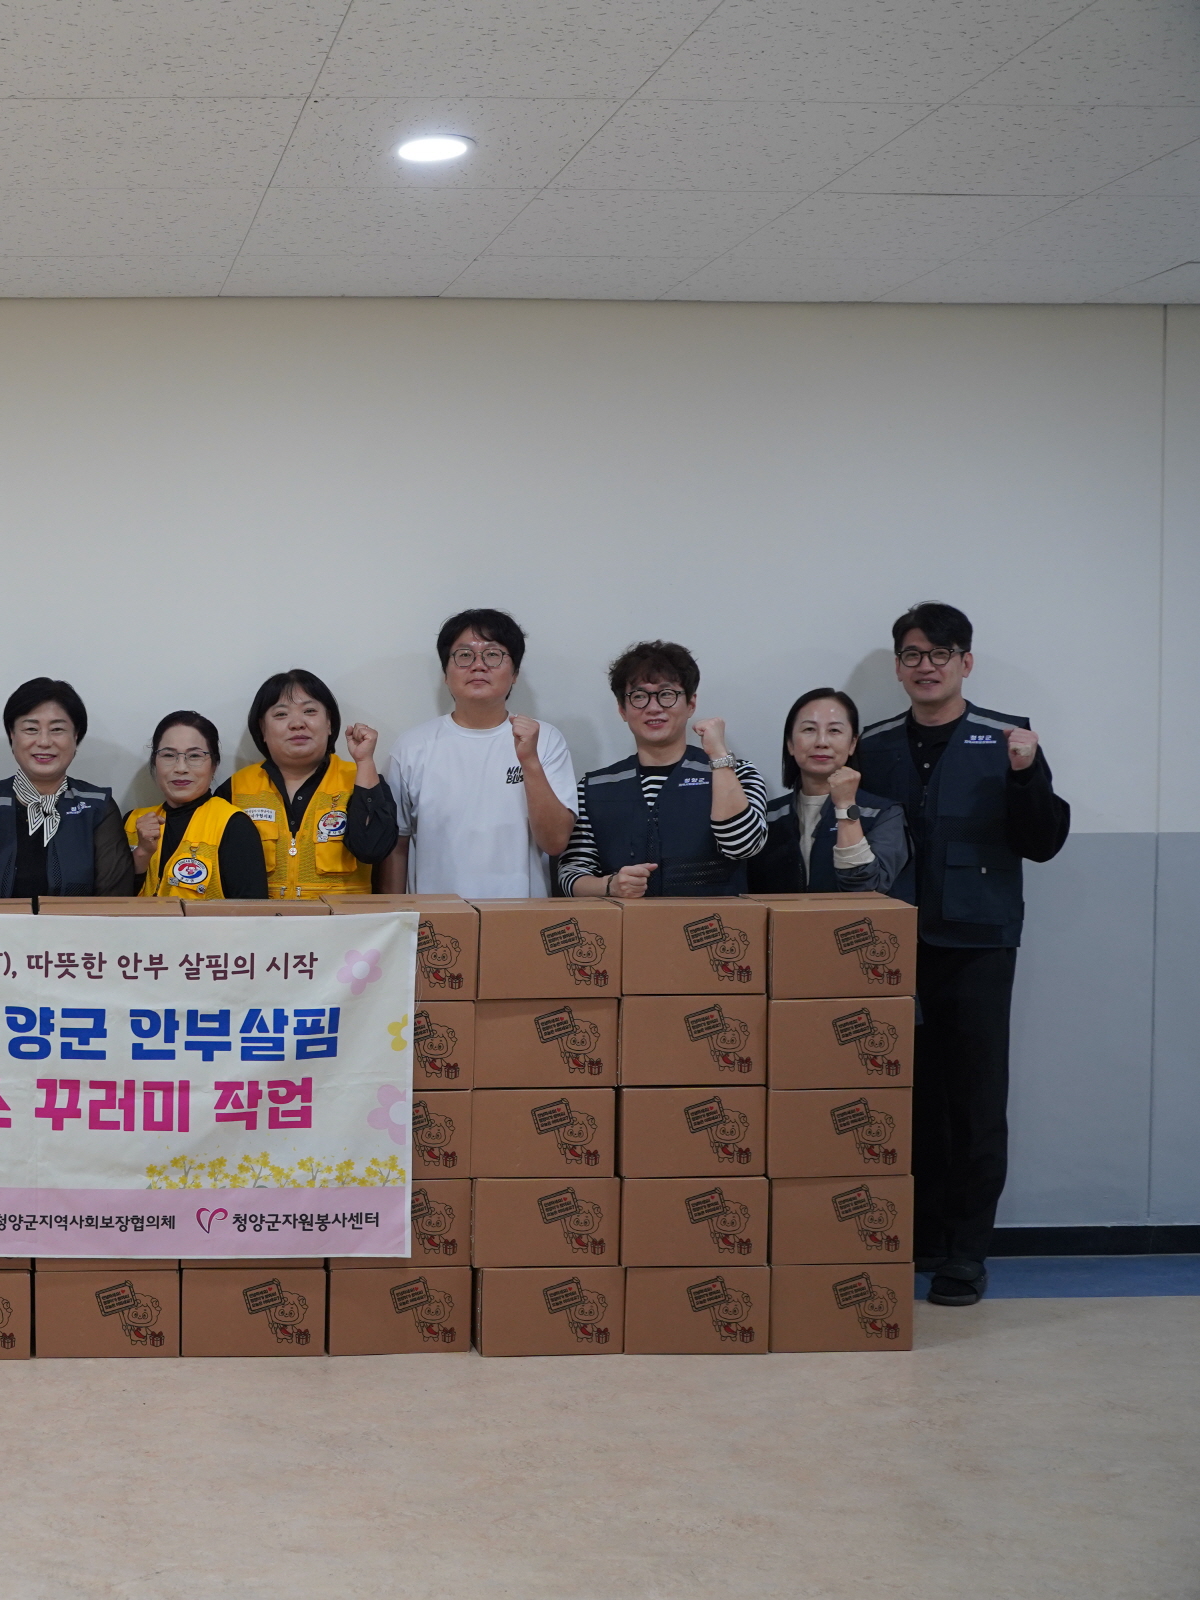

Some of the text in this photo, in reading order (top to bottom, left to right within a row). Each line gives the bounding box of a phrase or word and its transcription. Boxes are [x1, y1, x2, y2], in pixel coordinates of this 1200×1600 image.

[27, 951, 107, 979] 따뜻한
[118, 953, 168, 980] 안부
[179, 953, 254, 981] 살핌의
[266, 952, 318, 980] 시작
[130, 1007, 340, 1061] 안부살핌
[35, 1078, 190, 1132] 꾸러미
[214, 1077, 312, 1130] 작업
[232, 1211, 379, 1233] 청양군자원봉사센터
